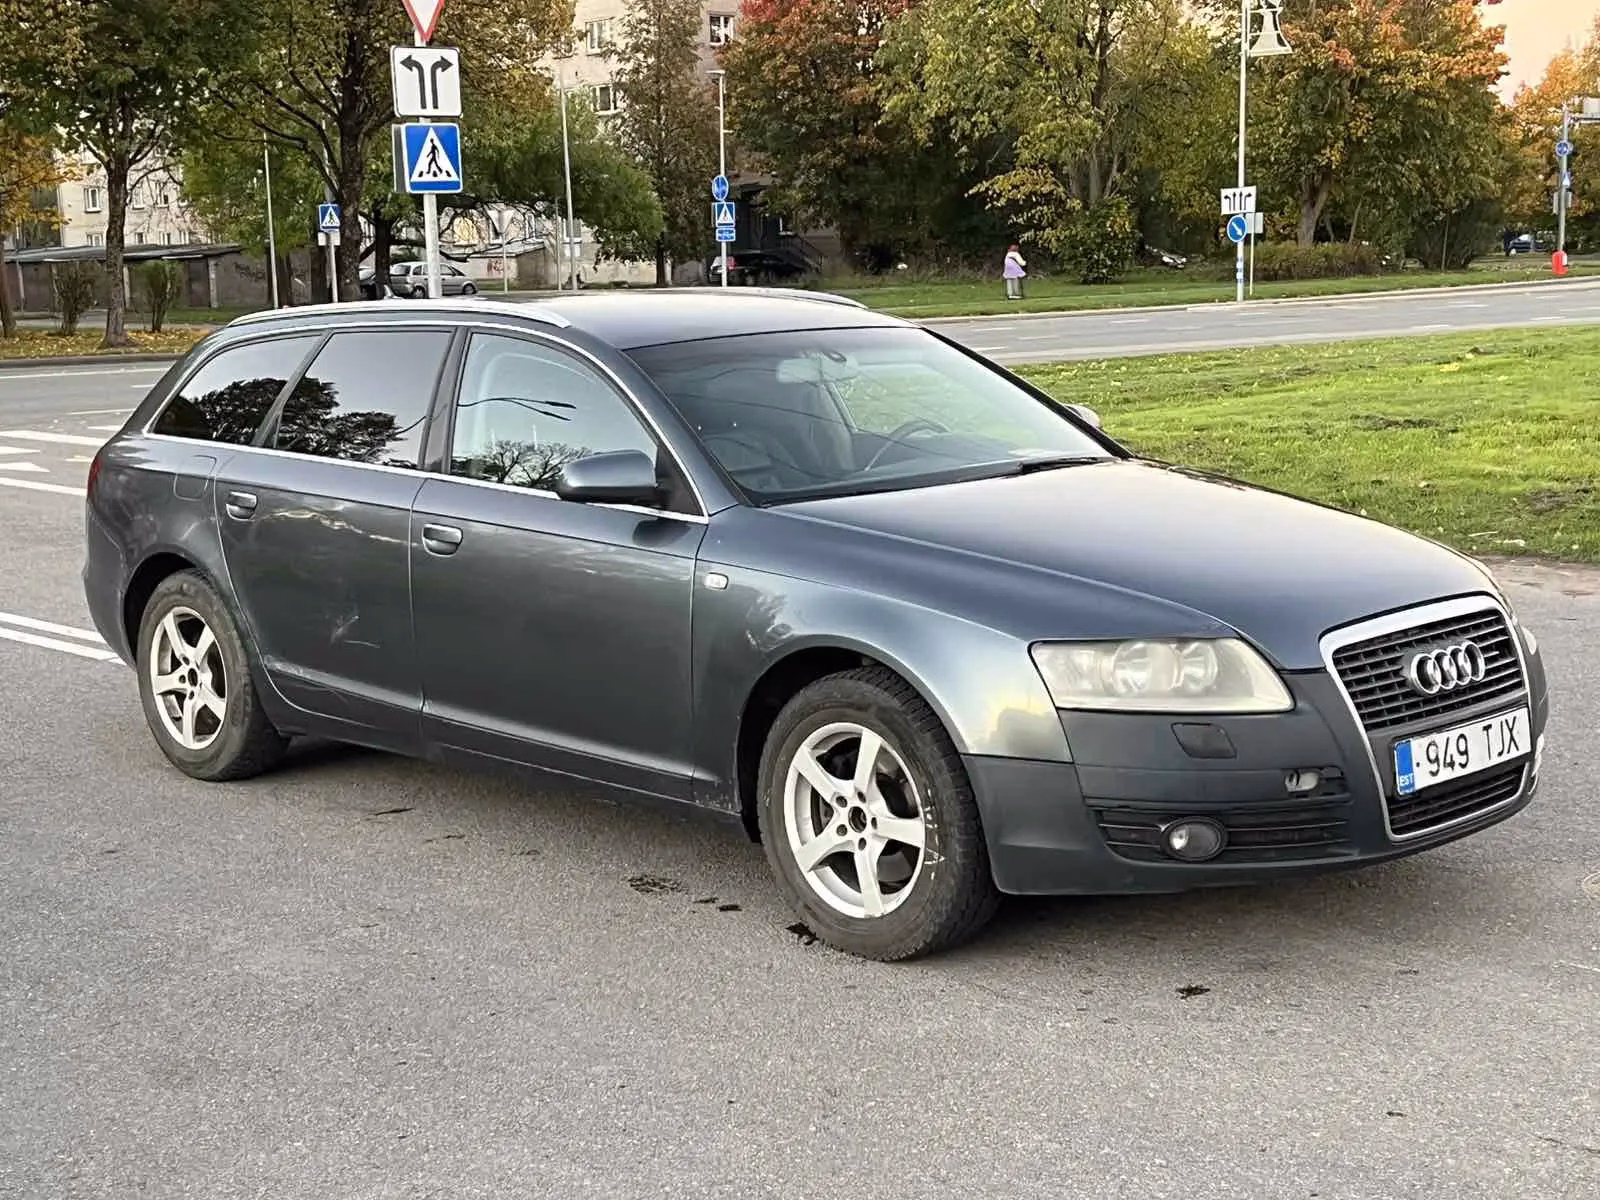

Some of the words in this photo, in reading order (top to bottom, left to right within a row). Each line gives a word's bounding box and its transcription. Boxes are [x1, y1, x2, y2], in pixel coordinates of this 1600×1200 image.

[1426, 733, 1469, 777] 949
[1482, 716, 1519, 760] TJX
[1399, 773, 1414, 786] EST
